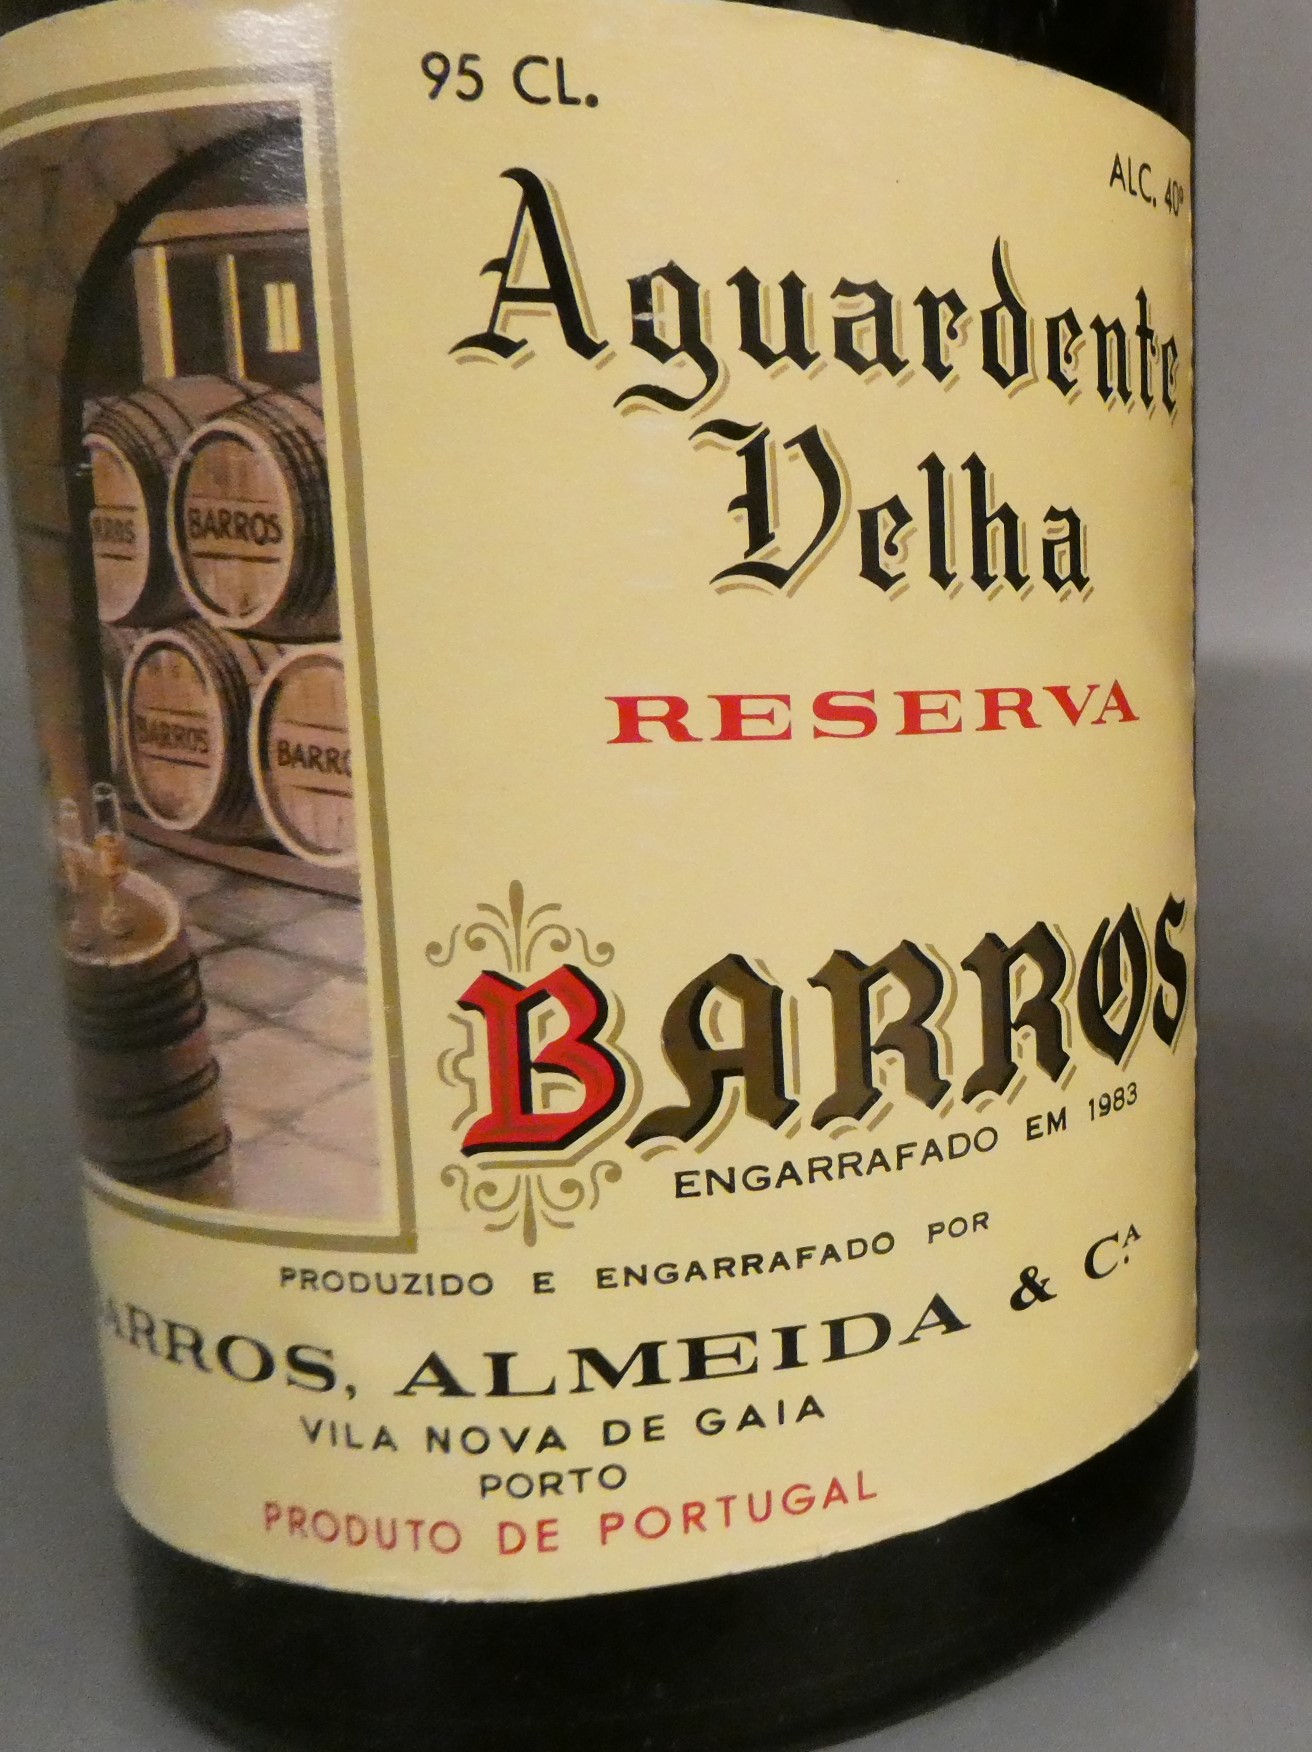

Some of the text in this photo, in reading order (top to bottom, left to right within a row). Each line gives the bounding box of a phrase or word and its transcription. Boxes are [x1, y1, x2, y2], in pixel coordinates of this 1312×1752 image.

[421, 51, 599, 108] 95 CL.
[1109, 152, 1157, 208] ALC.
[448, 167, 1183, 422] Aguardente
[187, 507, 283, 546] BARROS
[688, 418, 1094, 599] Velha
[604, 679, 1140, 744] RESERVA
[456, 892, 1188, 1156] BARROS
[674, 1081, 1138, 1198] ENGARRAFADO EM 1983
[280, 1211, 989, 1297] PRODUZIDO E ENGARRAFADO POR
[394, 1293, 971, 1397] ALMEIDA
[1009, 1265, 1058, 1312] &
[301, 1394, 826, 1455] VILA NOVA DE GAIA
[263, 1470, 877, 1555] PRODUTO DE PORTUGAL
[479, 1464, 627, 1499] PORTO
